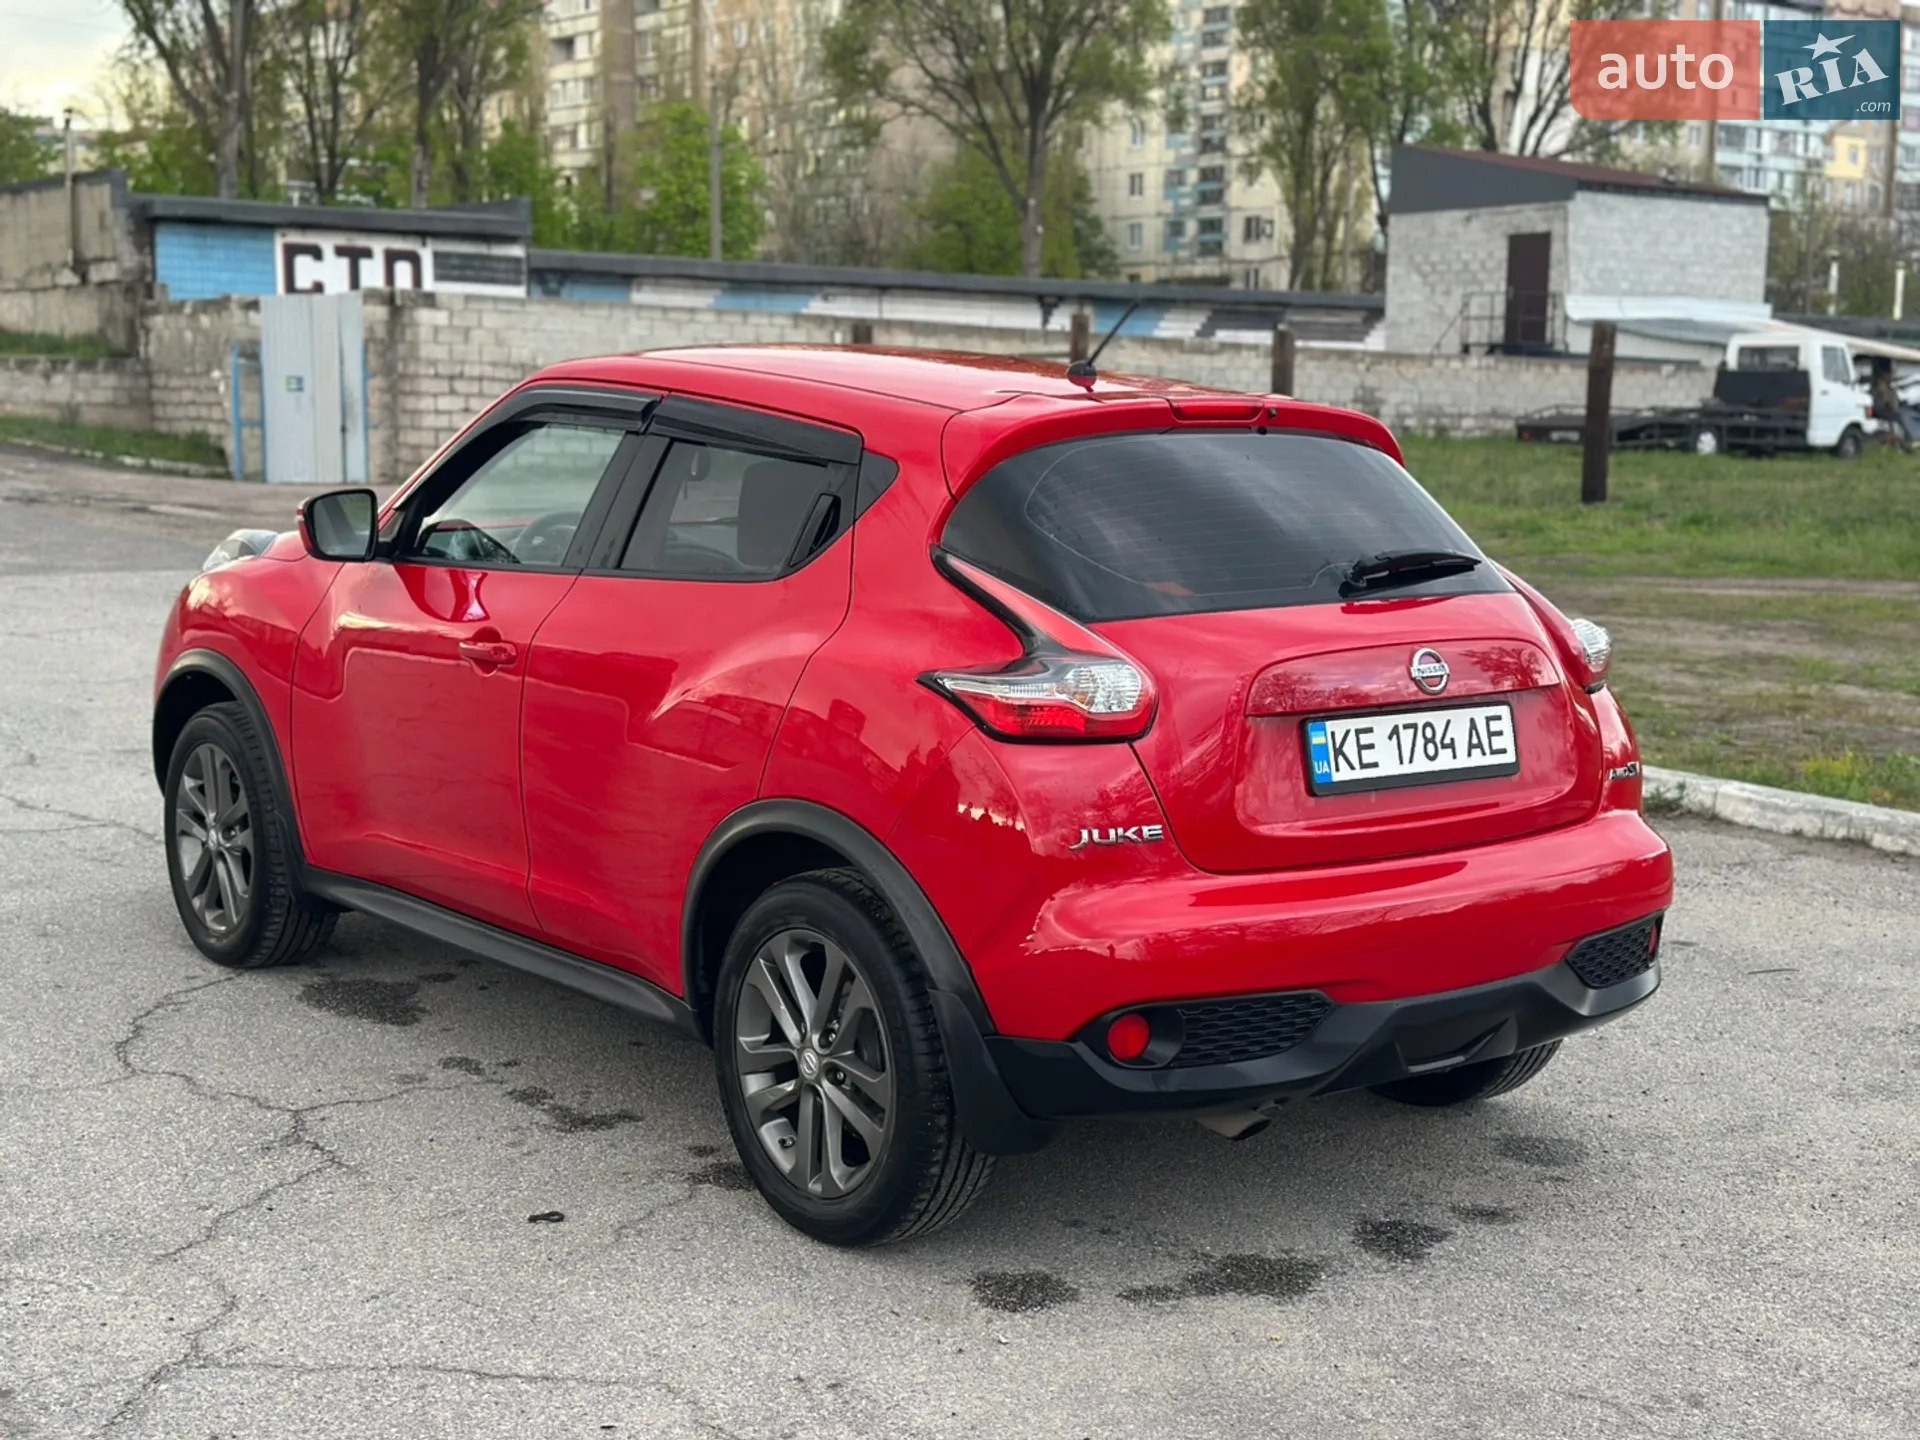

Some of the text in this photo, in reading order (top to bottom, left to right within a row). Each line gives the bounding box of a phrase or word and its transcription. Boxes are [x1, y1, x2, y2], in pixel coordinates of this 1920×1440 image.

[1330, 715, 1507, 772] KE 1784 AE
[1314, 760, 1330, 774] UA
[1069, 824, 1164, 850] JUKE
